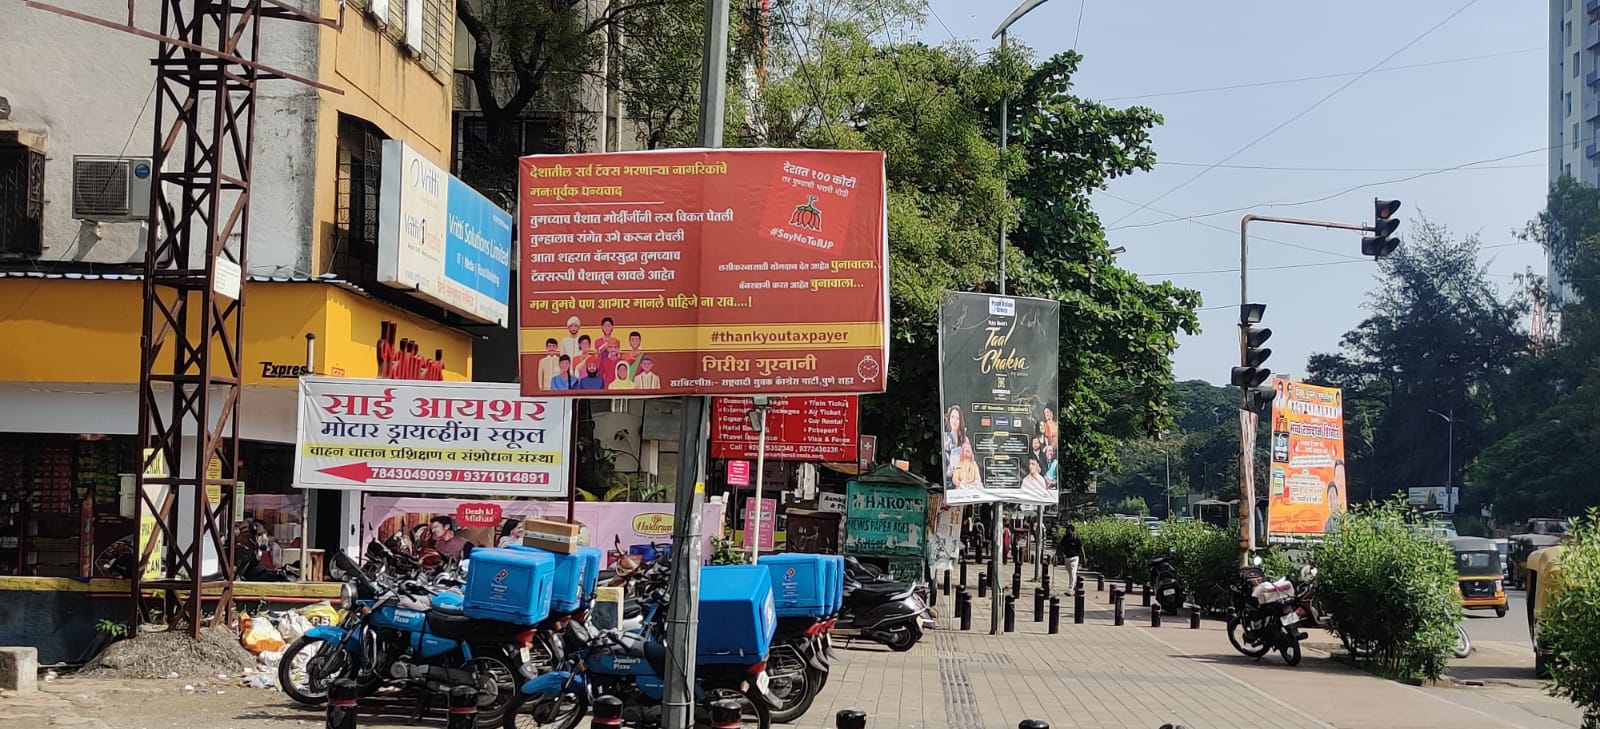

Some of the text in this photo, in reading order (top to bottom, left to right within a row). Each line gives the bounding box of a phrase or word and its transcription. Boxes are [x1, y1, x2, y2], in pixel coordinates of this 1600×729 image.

[530, 164, 572, 178] देशातील
[576, 164, 592, 177] सर्व
[672, 161, 728, 176] नागरिकांचे
[784, 160, 856, 188] देशात १०० कोटी
[582, 185, 622, 197] धन्यवाद
[530, 213, 570, 228] तुमच्याच
[574, 211, 600, 224] पैशात
[655, 212, 673, 222] लस
[676, 209, 704, 222] विकत
[706, 208, 734, 222] घेतली
[449, 212, 464, 240] Vritti
[464, 223, 490, 256] Solutions
[490, 239, 508, 266] Limited
[530, 229, 684, 248] तुम्हालाच रांगेत उभे करून टोचली
[770, 227, 834, 250] #SayNoToBJP
[530, 252, 554, 263] आता
[558, 252, 591, 262] शहरात
[640, 251, 680, 264] तुमच्याच
[811, 261, 830, 270] आहेत
[578, 268, 614, 284] पैशातून
[616, 267, 644, 280] लावले
[648, 266, 674, 280] आहेत
[530, 300, 548, 310] मग
[551, 296, 576, 314] तुमचे
[578, 298, 595, 309] पण
[598, 298, 630, 309] आभार
[633, 295, 664, 308] मानले
[667, 294, 698, 308] पाहिजे
[700, 296, 714, 307] ना
[711, 331, 848, 344] #thankyoutaxpayer
[984, 312, 1018, 350] Taal
[702, 353, 817, 376] गिरीश गुरनानी
[972, 348, 1030, 374] Chakra
[322, 388, 548, 422] साई आयशर
[320, 416, 380, 438] मोटार
[488, 428, 546, 450] स्कूल
[310, 446, 554, 464] वाहन चालन प्रशिक्षण व संशोधन संस्था
[370, 468, 452, 480] 7843049099
[464, 470, 544, 483] 9371014891
